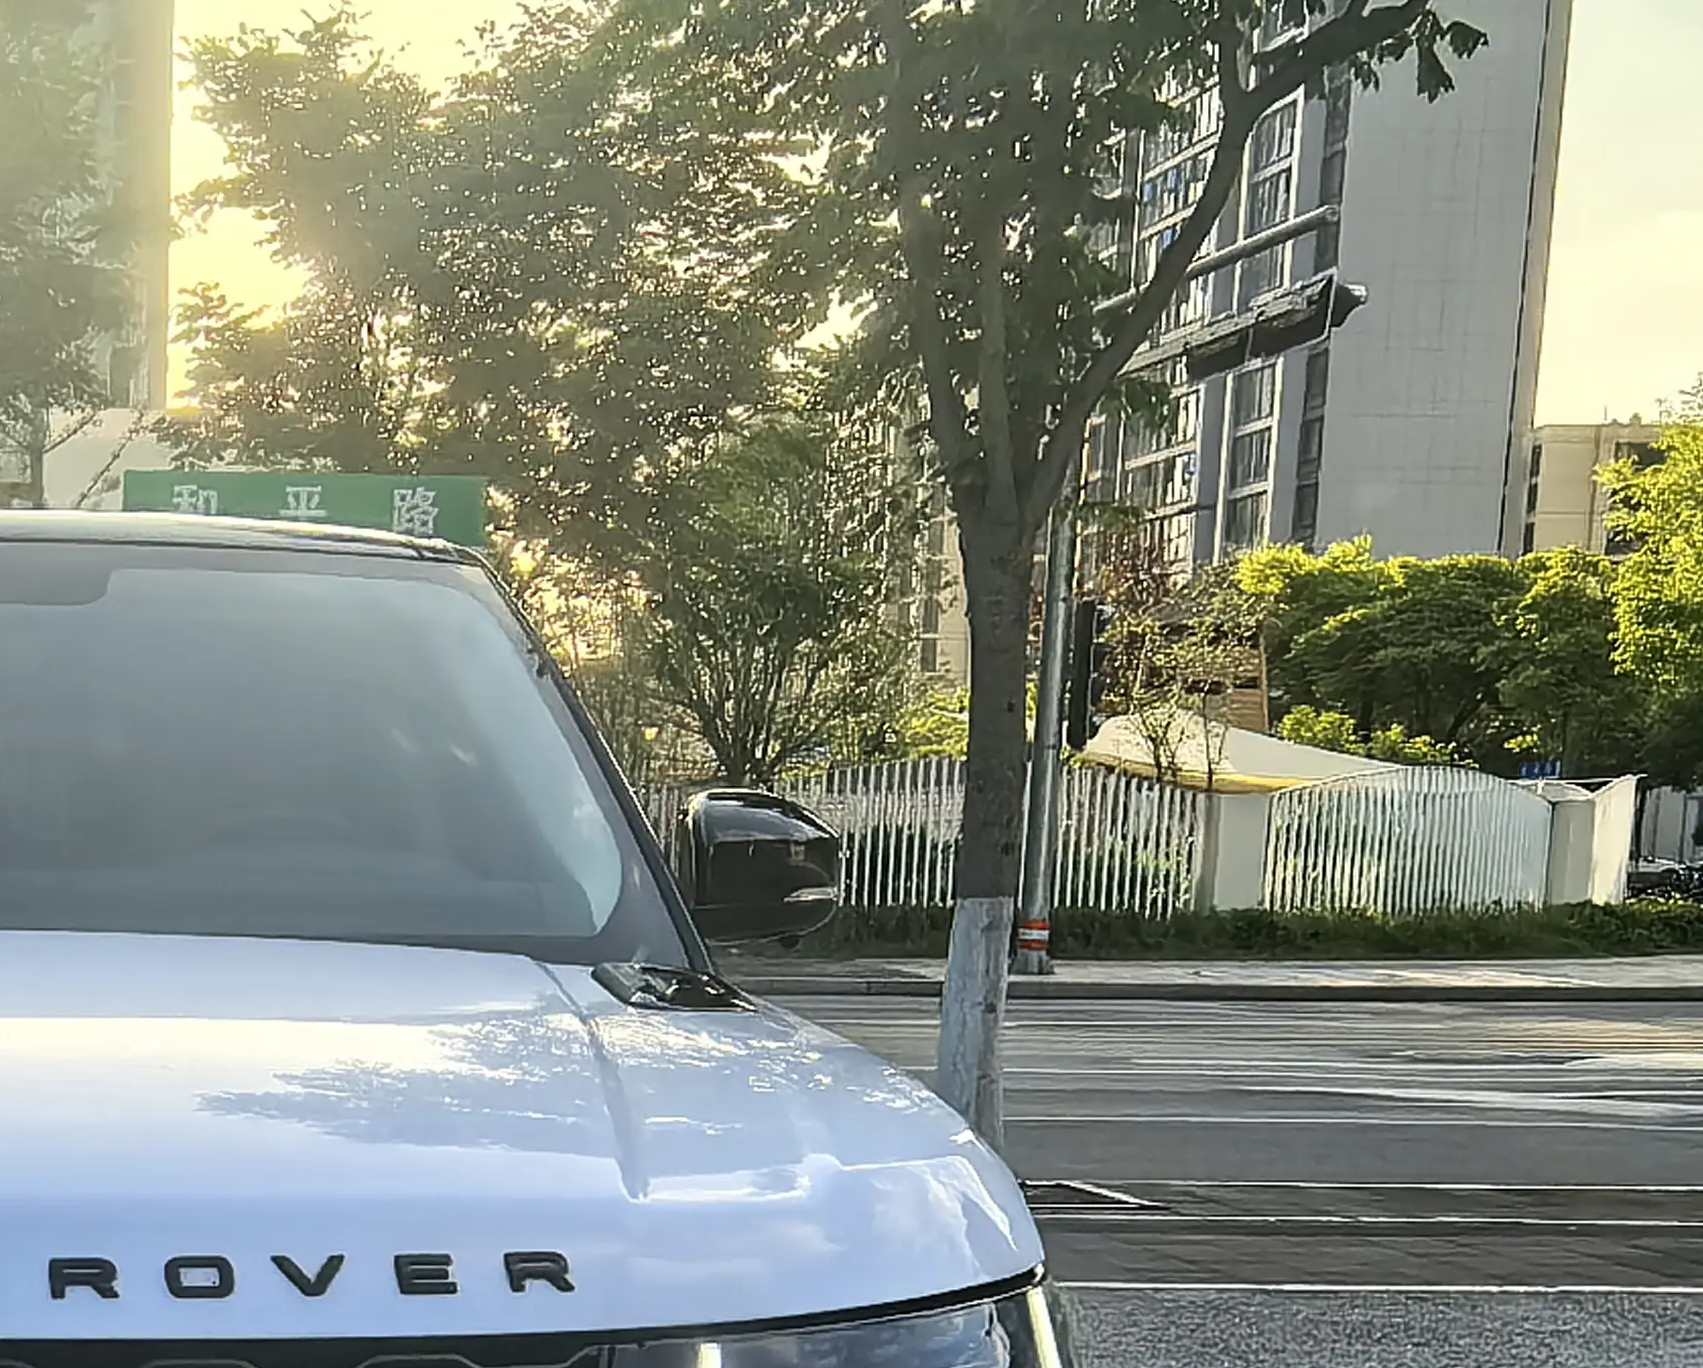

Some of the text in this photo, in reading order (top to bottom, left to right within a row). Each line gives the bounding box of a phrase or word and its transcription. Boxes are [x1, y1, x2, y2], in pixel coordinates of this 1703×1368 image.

[172, 484, 439, 535] 和平路
[47, 1250, 577, 1301] ROVER
